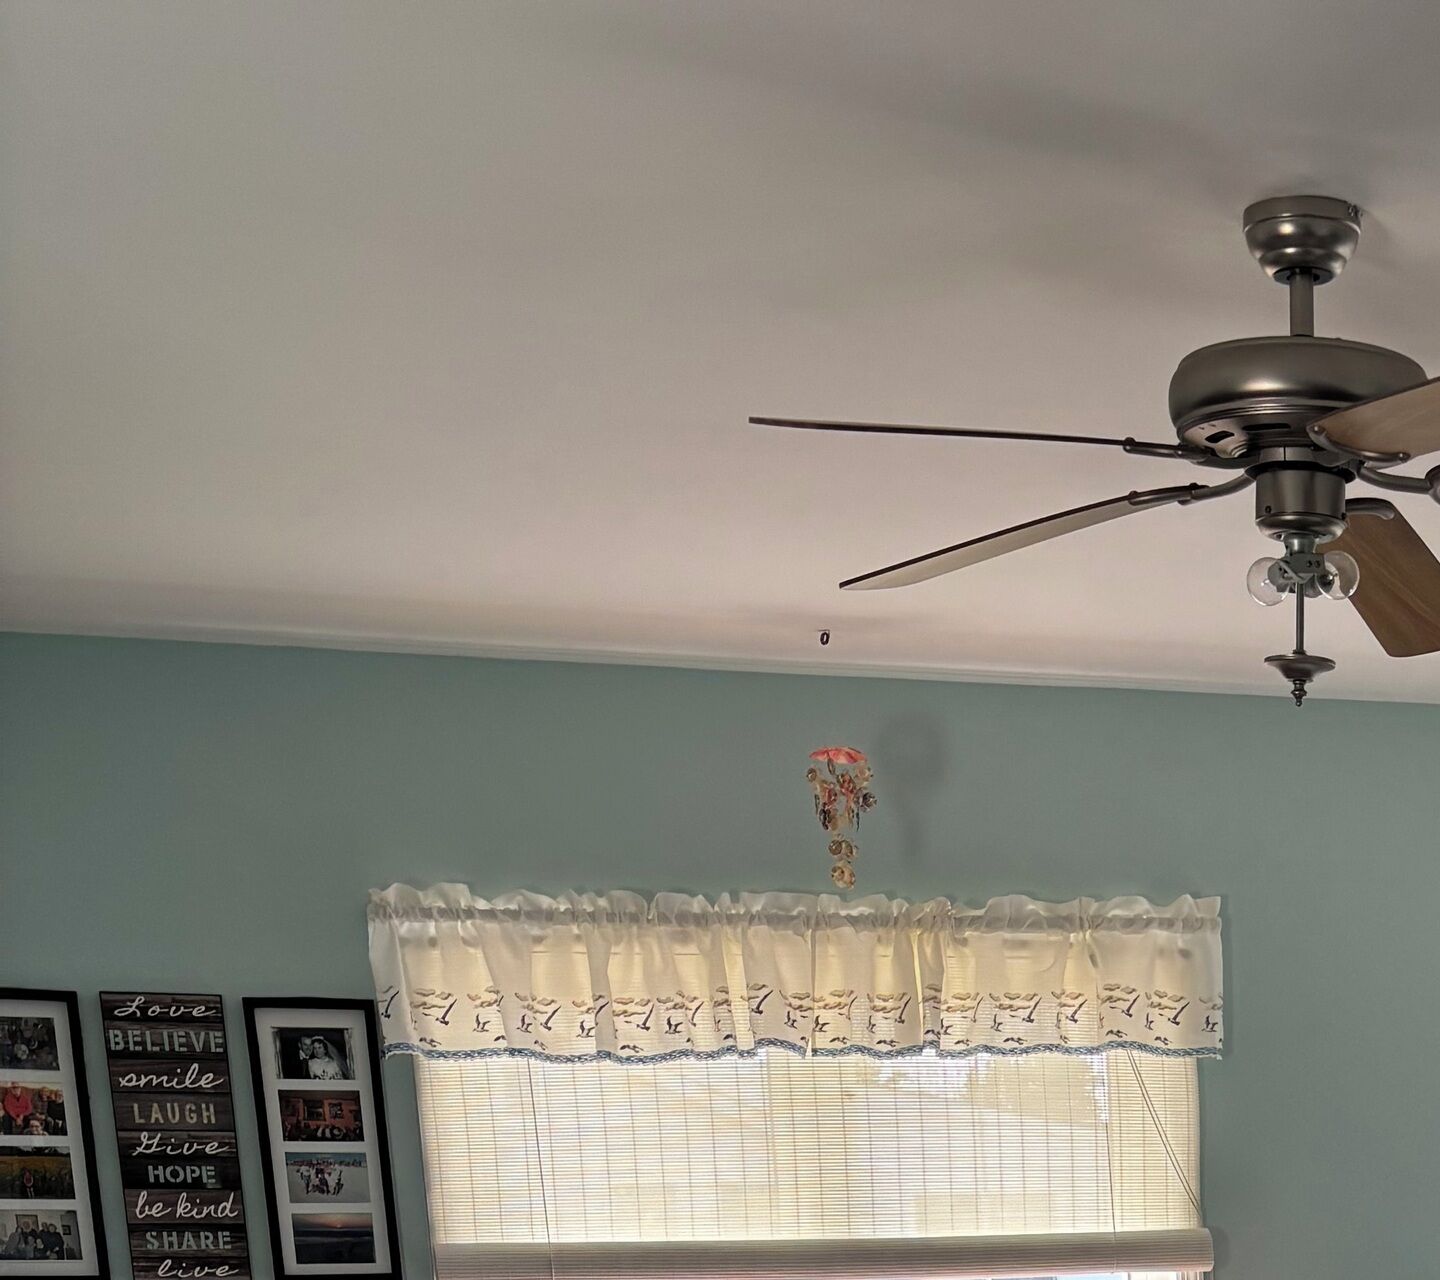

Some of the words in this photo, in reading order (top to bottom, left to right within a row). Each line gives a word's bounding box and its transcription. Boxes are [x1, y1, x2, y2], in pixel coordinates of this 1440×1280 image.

[113, 995, 217, 1018] Love
[108, 1028, 225, 1053] BELIEVE
[118, 1062, 225, 1090] smile
[132, 1102, 217, 1125] LAUGH
[133, 1131, 228, 1156] Give
[147, 1165, 217, 1184] HOPE
[135, 1190, 172, 1218] be
[176, 1191, 239, 1219] kind
[145, 1231, 232, 1251] SHARE
[156, 1258, 240, 1279] live
